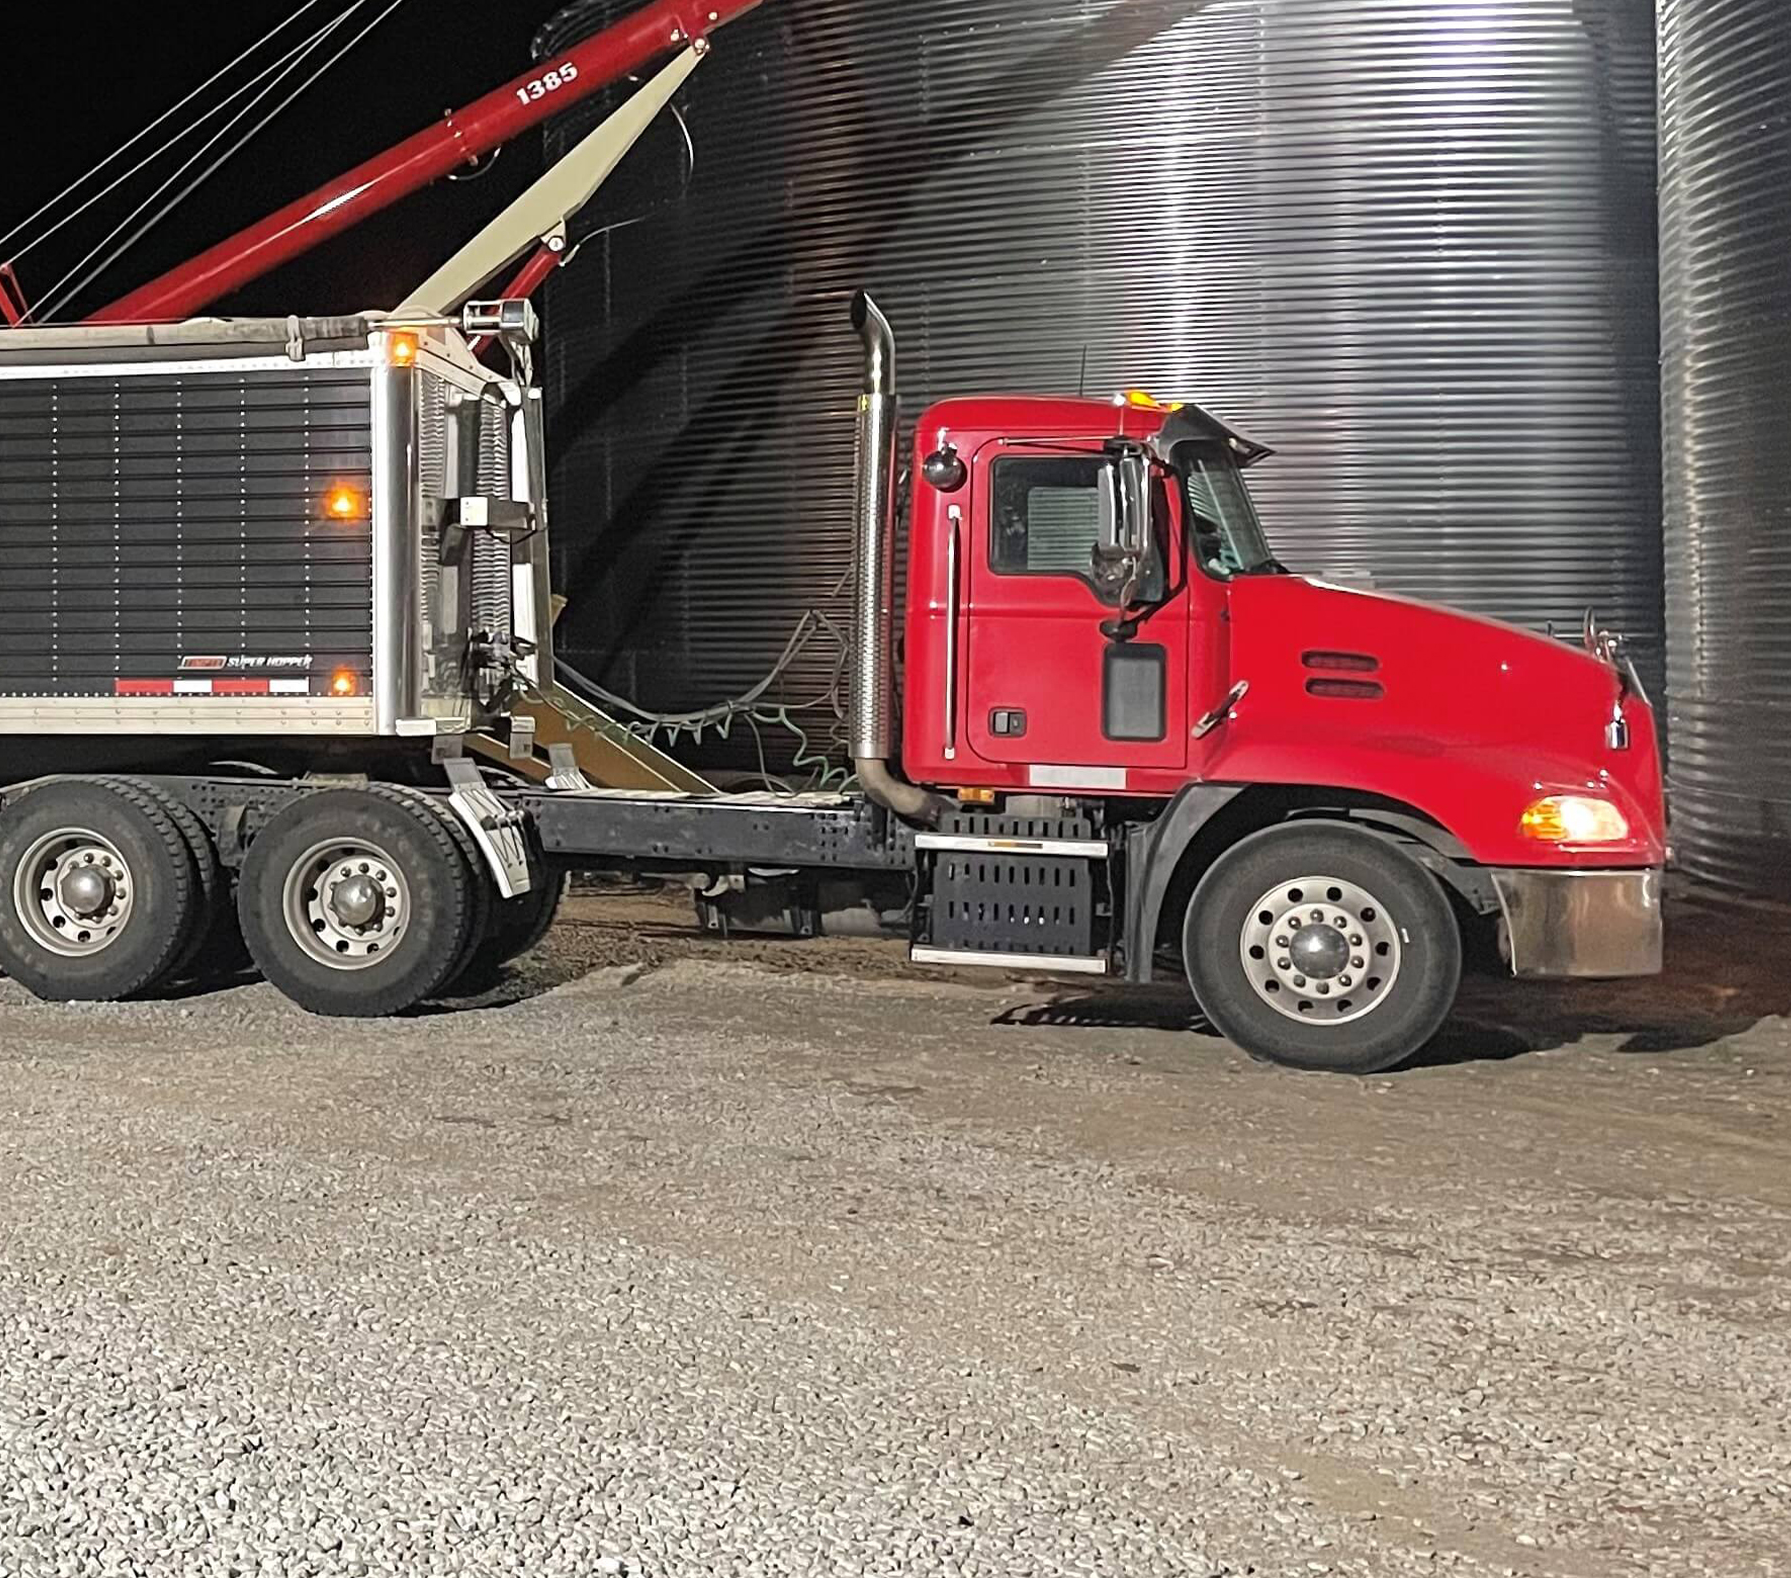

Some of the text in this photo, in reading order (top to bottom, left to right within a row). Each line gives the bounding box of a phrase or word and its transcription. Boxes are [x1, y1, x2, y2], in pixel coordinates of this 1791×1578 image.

[516, 62, 578, 105] 1385
[227, 656, 265, 667] SUPER
[266, 656, 313, 667] HOPPER
